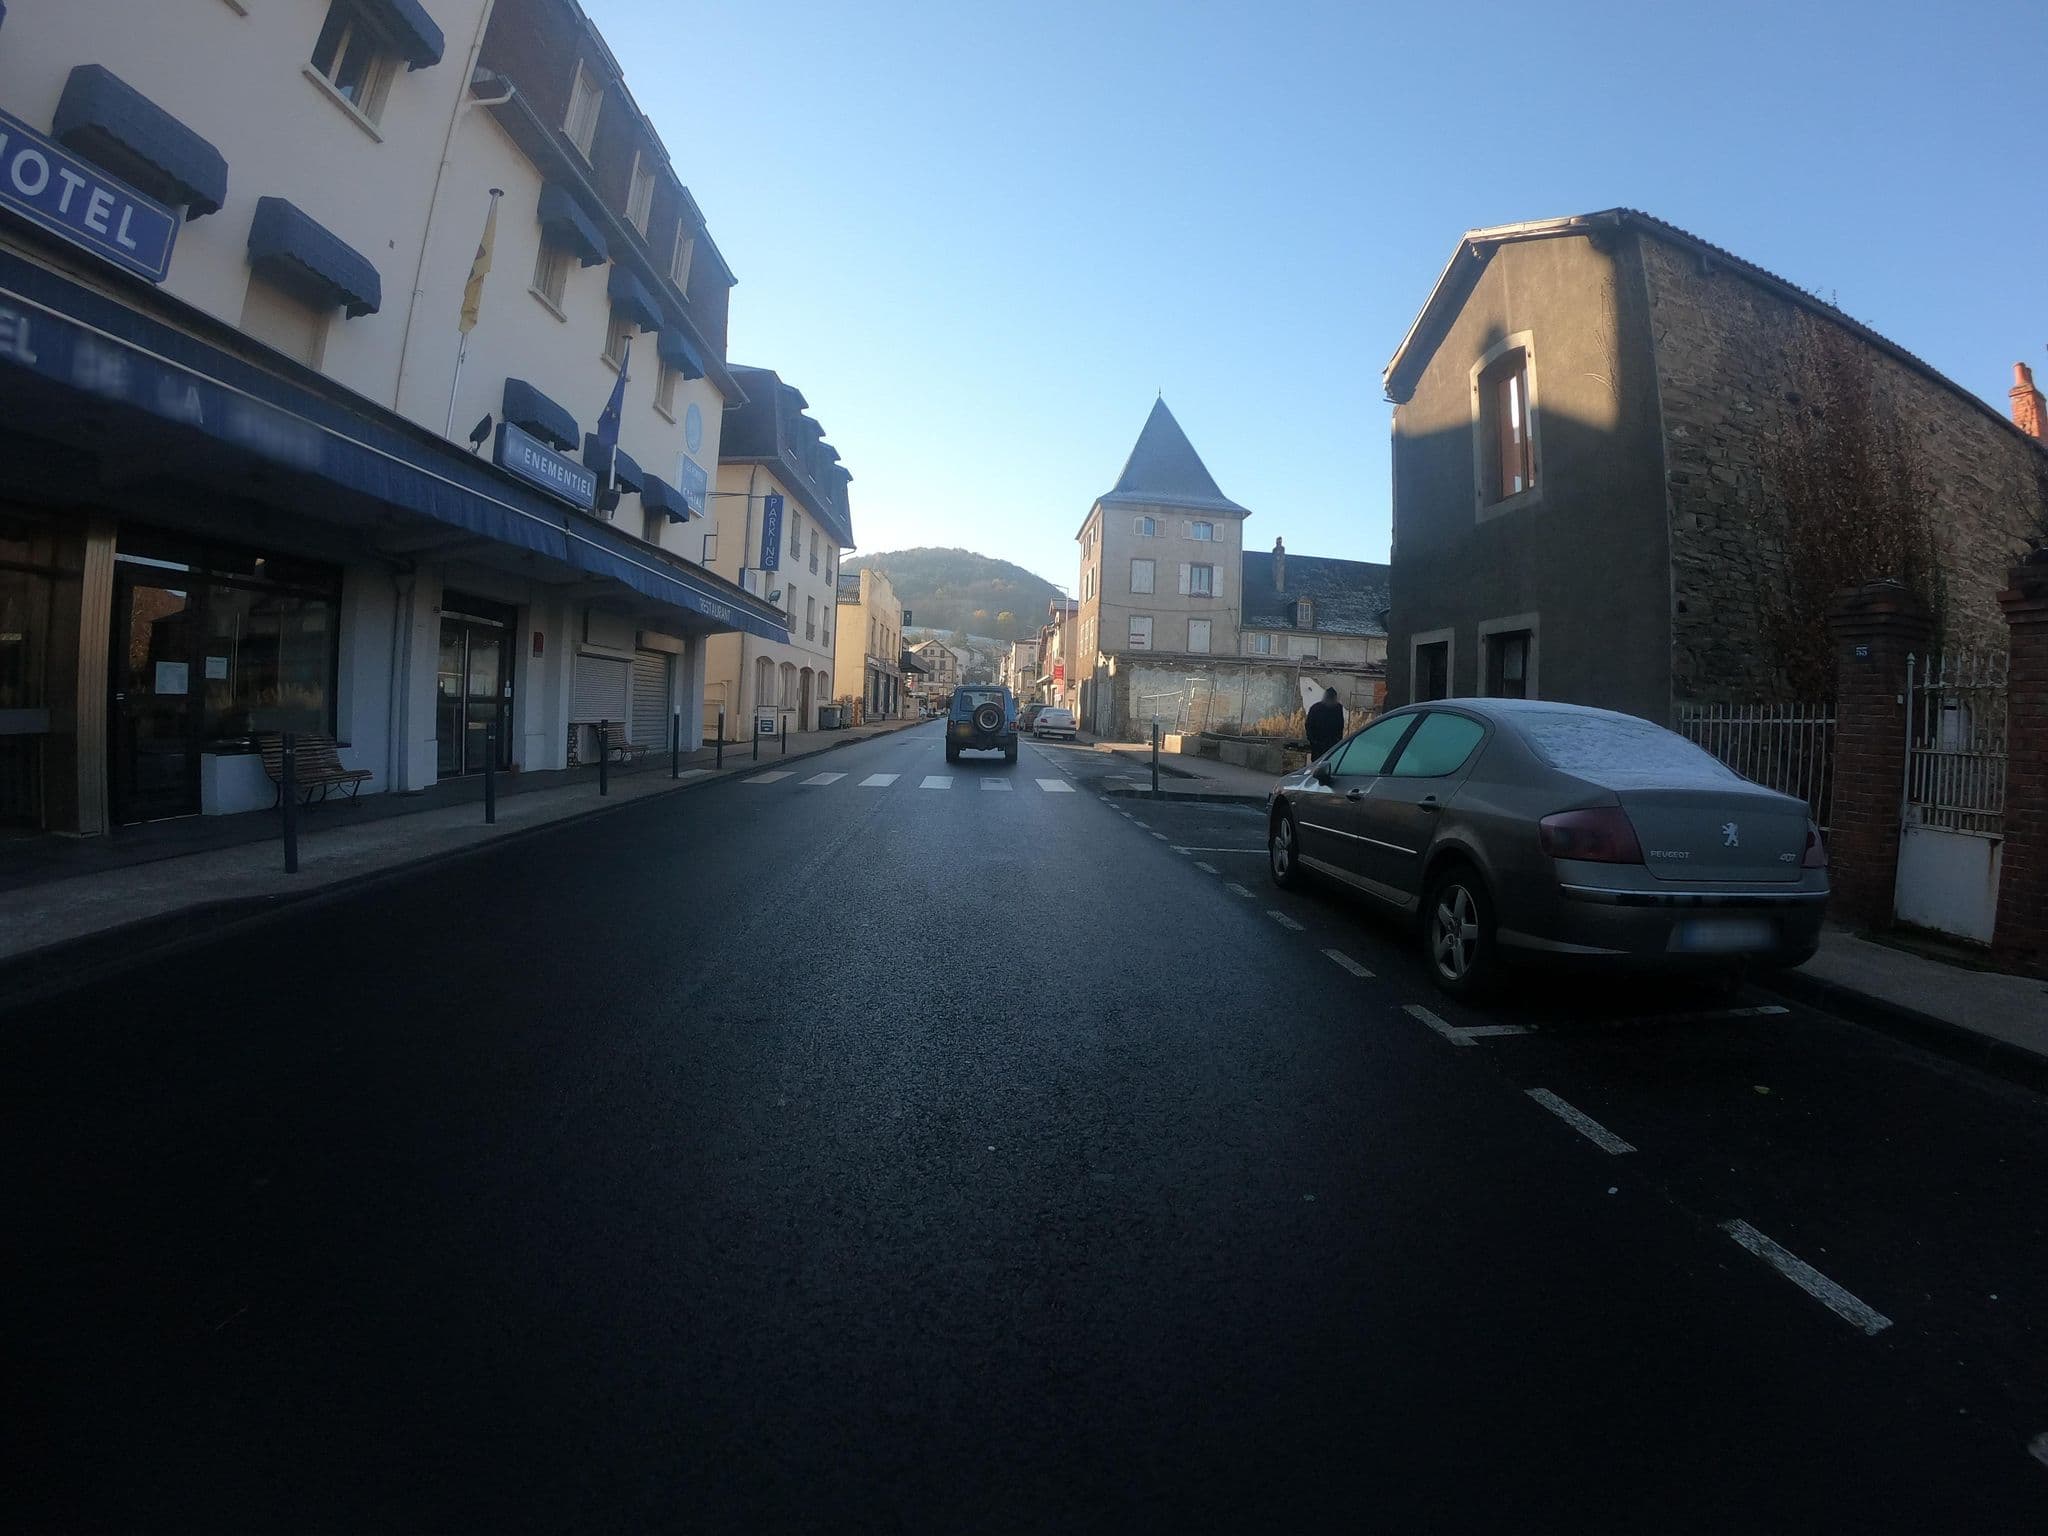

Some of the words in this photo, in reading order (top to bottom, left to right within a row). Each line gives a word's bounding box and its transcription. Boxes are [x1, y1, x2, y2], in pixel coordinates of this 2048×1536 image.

[512, 441, 592, 497] ENEMENTIEL
[765, 498, 777, 567] PARKING
[1650, 850, 1690, 860] PEUGEOT
[1779, 853, 1797, 863] 407
